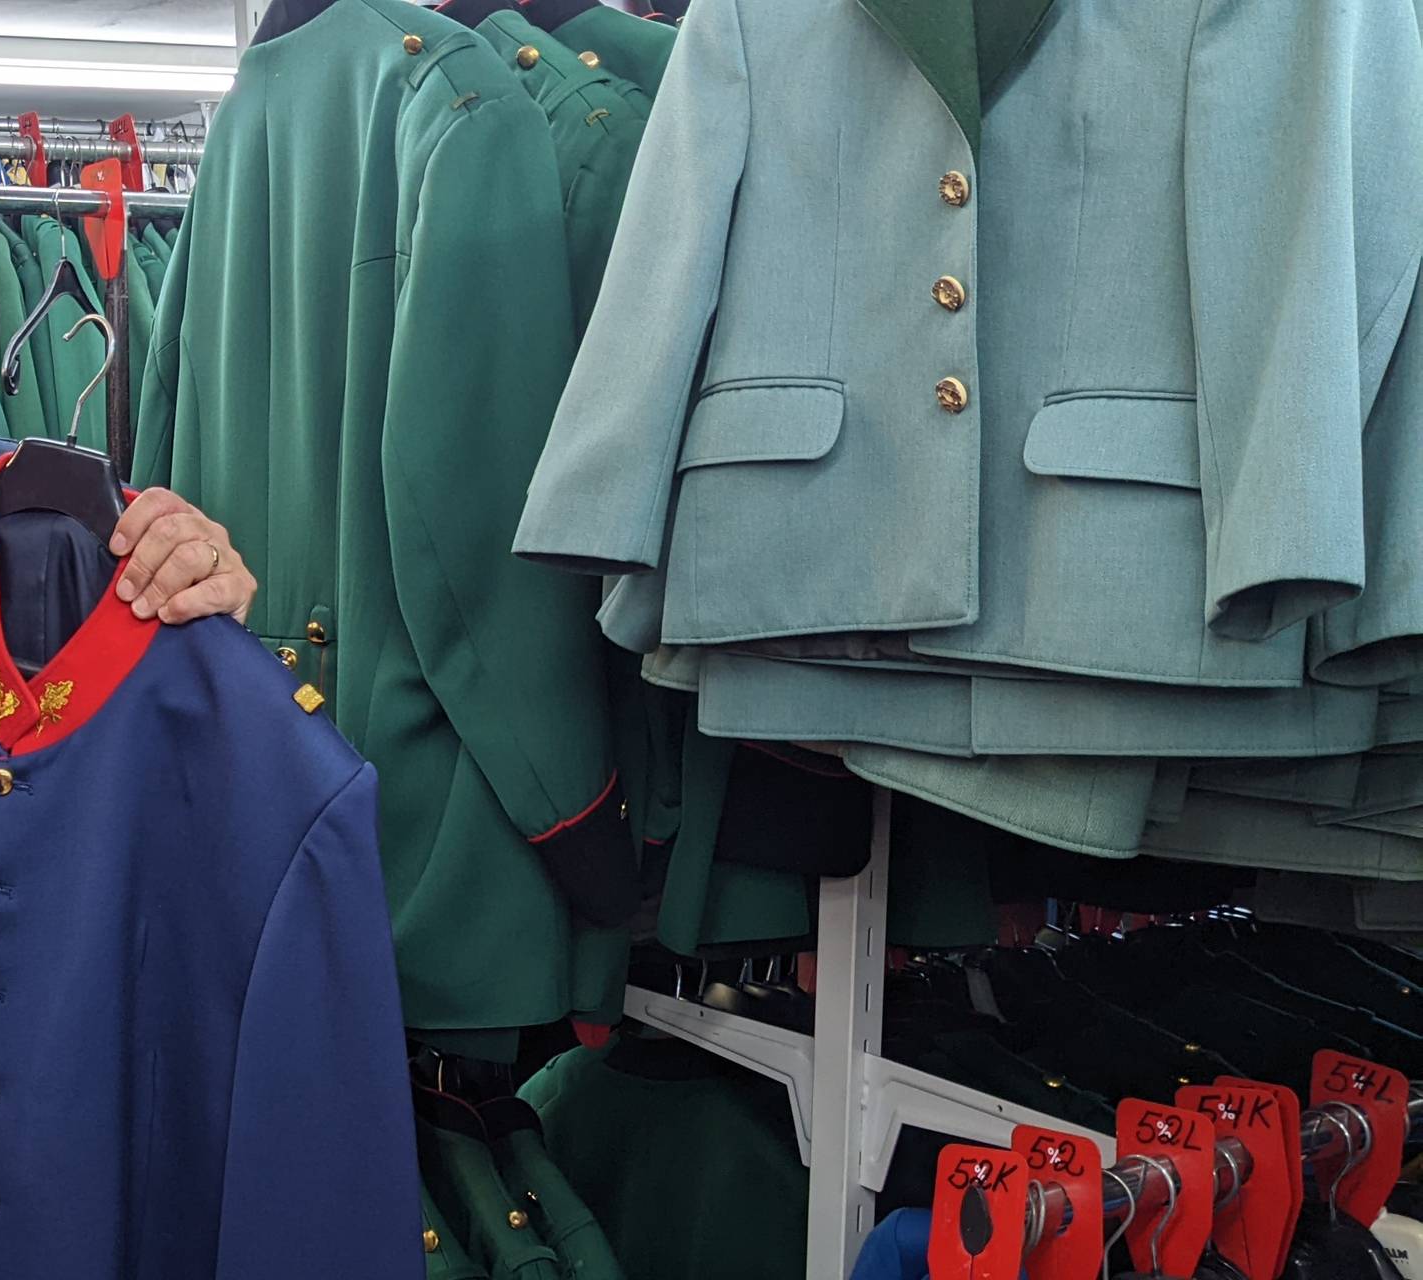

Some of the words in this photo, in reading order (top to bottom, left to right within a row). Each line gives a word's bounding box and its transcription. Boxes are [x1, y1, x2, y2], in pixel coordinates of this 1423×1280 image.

[1136, 1110, 1202, 1151] 52L
[1196, 1093, 1274, 1130] 54K
[947, 1157, 1018, 1193] 52K
[1027, 1136, 1085, 1177] 52
